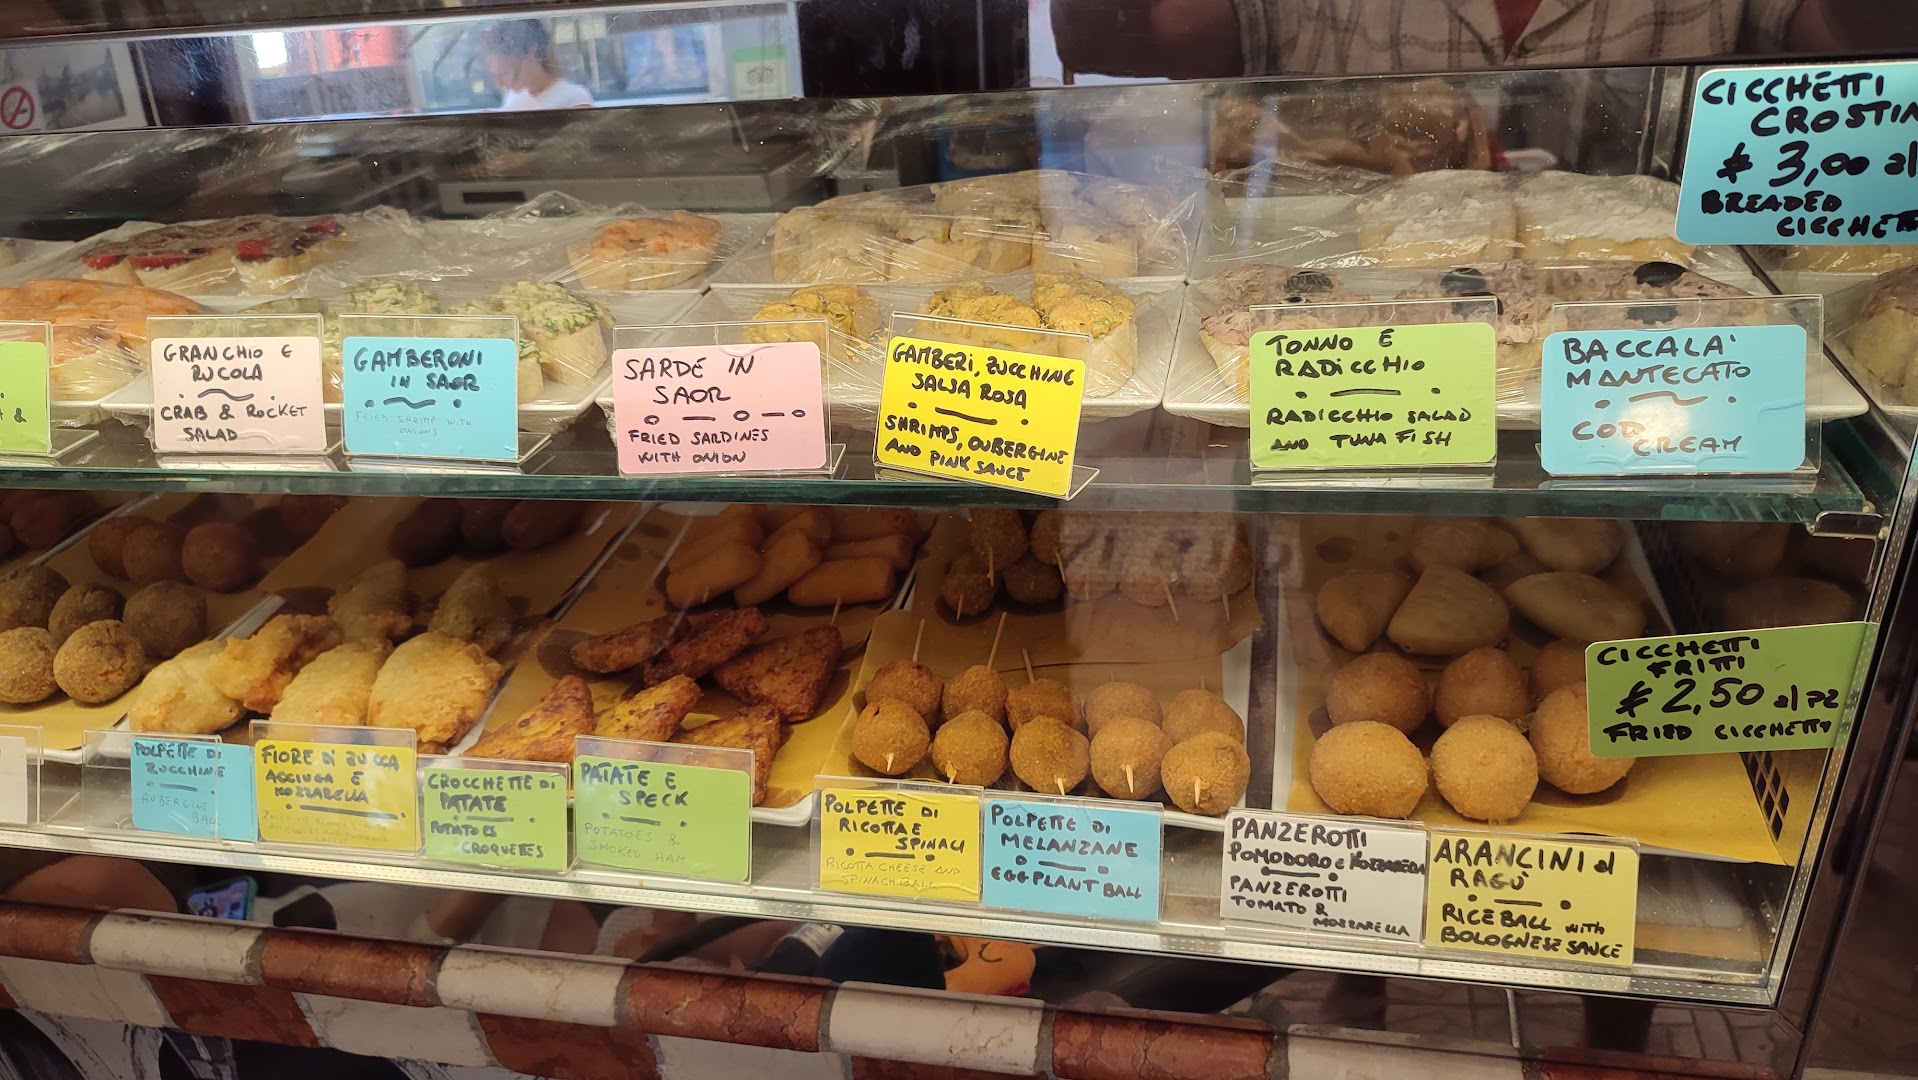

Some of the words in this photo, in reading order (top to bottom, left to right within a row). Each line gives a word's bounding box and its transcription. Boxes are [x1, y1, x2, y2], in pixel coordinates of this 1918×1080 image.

[1702, 71, 1884, 105] CICCHETTI
[1769, 141, 1870, 187] 3,00
[1701, 189, 1842, 214] BREADED
[163, 344, 263, 361] GRANCHIO
[281, 344, 292, 358] E
[1265, 335, 1354, 356] TONNO
[1378, 328, 1395, 348] E
[353, 347, 483, 372] GAMBERONI
[624, 357, 707, 381] SARDE
[728, 355, 755, 376] IN
[986, 356, 1075, 386] ZUCCHINE
[1275, 355, 1425, 379] RADICCHIO
[192, 364, 263, 381] RUCOLA
[390, 375, 411, 389] IN
[426, 372, 480, 392] SAOR
[1566, 361, 1751, 388] MANTECATO
[652, 386, 731, 404] SAOR
[911, 373, 971, 398] SALSA
[979, 383, 1027, 409] ROSA
[161, 405, 208, 420] CRAB
[219, 405, 235, 419] &
[246, 405, 308, 418] ROCKET
[1266, 408, 1393, 426] RADICCHIO
[1407, 408, 1472, 424] SALAD
[183, 428, 238, 441] SALAD
[628, 430, 681, 445] FRIED
[690, 428, 769, 446] SARDINES
[1270, 438, 1309, 451] AND
[1329, 432, 1387, 449] TUNA
[1395, 429, 1452, 447] FISH
[1571, 420, 1646, 441] COD
[638, 451, 682, 464] WITH
[692, 451, 747, 463] ONION
[967, 435, 1069, 465] OUBERGINE
[1632, 435, 1743, 457] CREAM
[885, 437, 922, 457] AND
[930, 449, 971, 471] PINK
[974, 460, 1031, 482] SAUCE
[1597, 636, 1760, 666] CICCHETTI
[1646, 655, 1745, 678] FRITTI
[1661, 677, 1765, 716] 2,50
[1602, 722, 1692, 743] FRIED
[134, 741, 197, 759] POLPETTE
[206, 748, 222, 759] DI
[261, 744, 314, 766] FIORE
[345, 750, 400, 772] ZUCCA
[145, 761, 226, 778] ZUCCHINE
[265, 768, 334, 784] ACCIUGA
[350, 771, 365, 786] E
[580, 762, 651, 787] PATATE
[664, 771, 677, 790] E
[427, 773, 533, 792] CROCCHETTE
[539, 779, 556, 790] DI
[142, 792, 208, 811] AUBERGINE
[439, 791, 508, 814] PATATE
[619, 790, 689, 808] SPECK
[825, 793, 907, 817] POLPETTE
[921, 806, 939, 819] DI
[430, 820, 497, 838] POTATOES
[839, 817, 908, 836] RICOTTA
[911, 822, 922, 836] E
[991, 804, 1077, 832] POLPETTE
[1092, 820, 1111, 835] DI
[584, 822, 653, 843] POTATOES
[668, 833, 680, 846] &
[1232, 817, 1367, 849] PANZEROTTI
[588, 839, 642, 859] SMOKED
[655, 853, 686, 865] HAM
[895, 836, 965, 854] SPINACI
[1000, 832, 1139, 858] MELANZANE
[1228, 841, 1332, 868] POMODORO
[1433, 838, 1585, 873] ARANCINI
[826, 857, 874, 871] RICOTTA
[878, 862, 926, 874] CHEESE
[934, 866, 961, 876] AND
[840, 874, 896, 886] SPINACH
[990, 866, 1100, 893] EGGPLANT
[1103, 882, 1142, 899] BALL
[1230, 875, 1347, 902] PANZEROTTI
[1230, 896, 1307, 914] TOMATO
[1313, 917, 1410, 937] MOZZARELLA
[1442, 903, 1495, 925] RICE
[1500, 910, 1552, 931] BALL
[1441, 926, 1562, 952] BOLOGNESE
[1565, 940, 1623, 958] SAUCE
